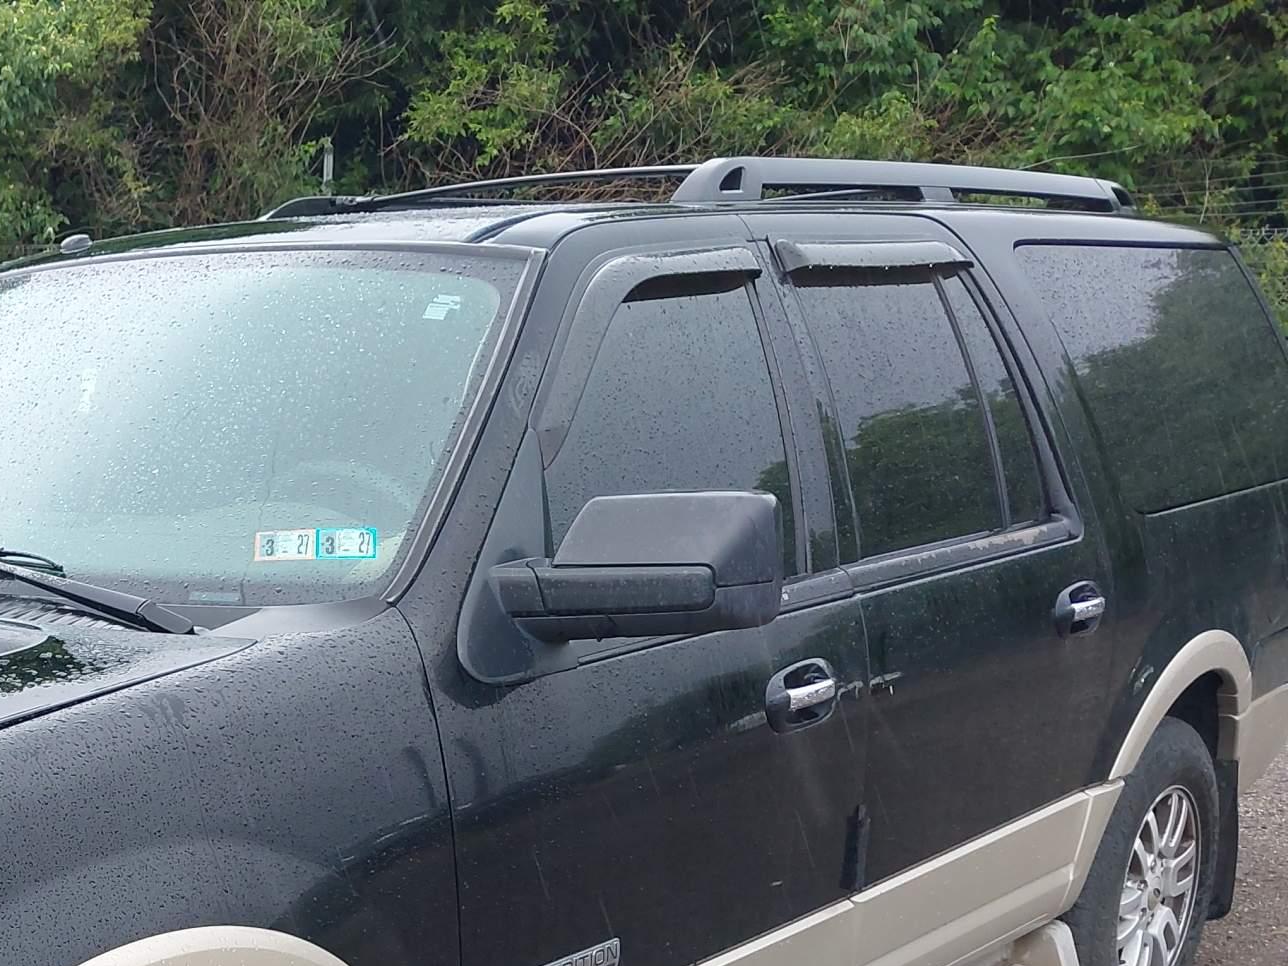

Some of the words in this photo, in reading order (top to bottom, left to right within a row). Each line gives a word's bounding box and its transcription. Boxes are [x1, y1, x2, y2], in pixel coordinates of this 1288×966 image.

[265, 538, 274, 556] 3
[297, 534, 310, 556] 27
[325, 536, 335, 555] 3
[358, 532, 371, 554] 27
